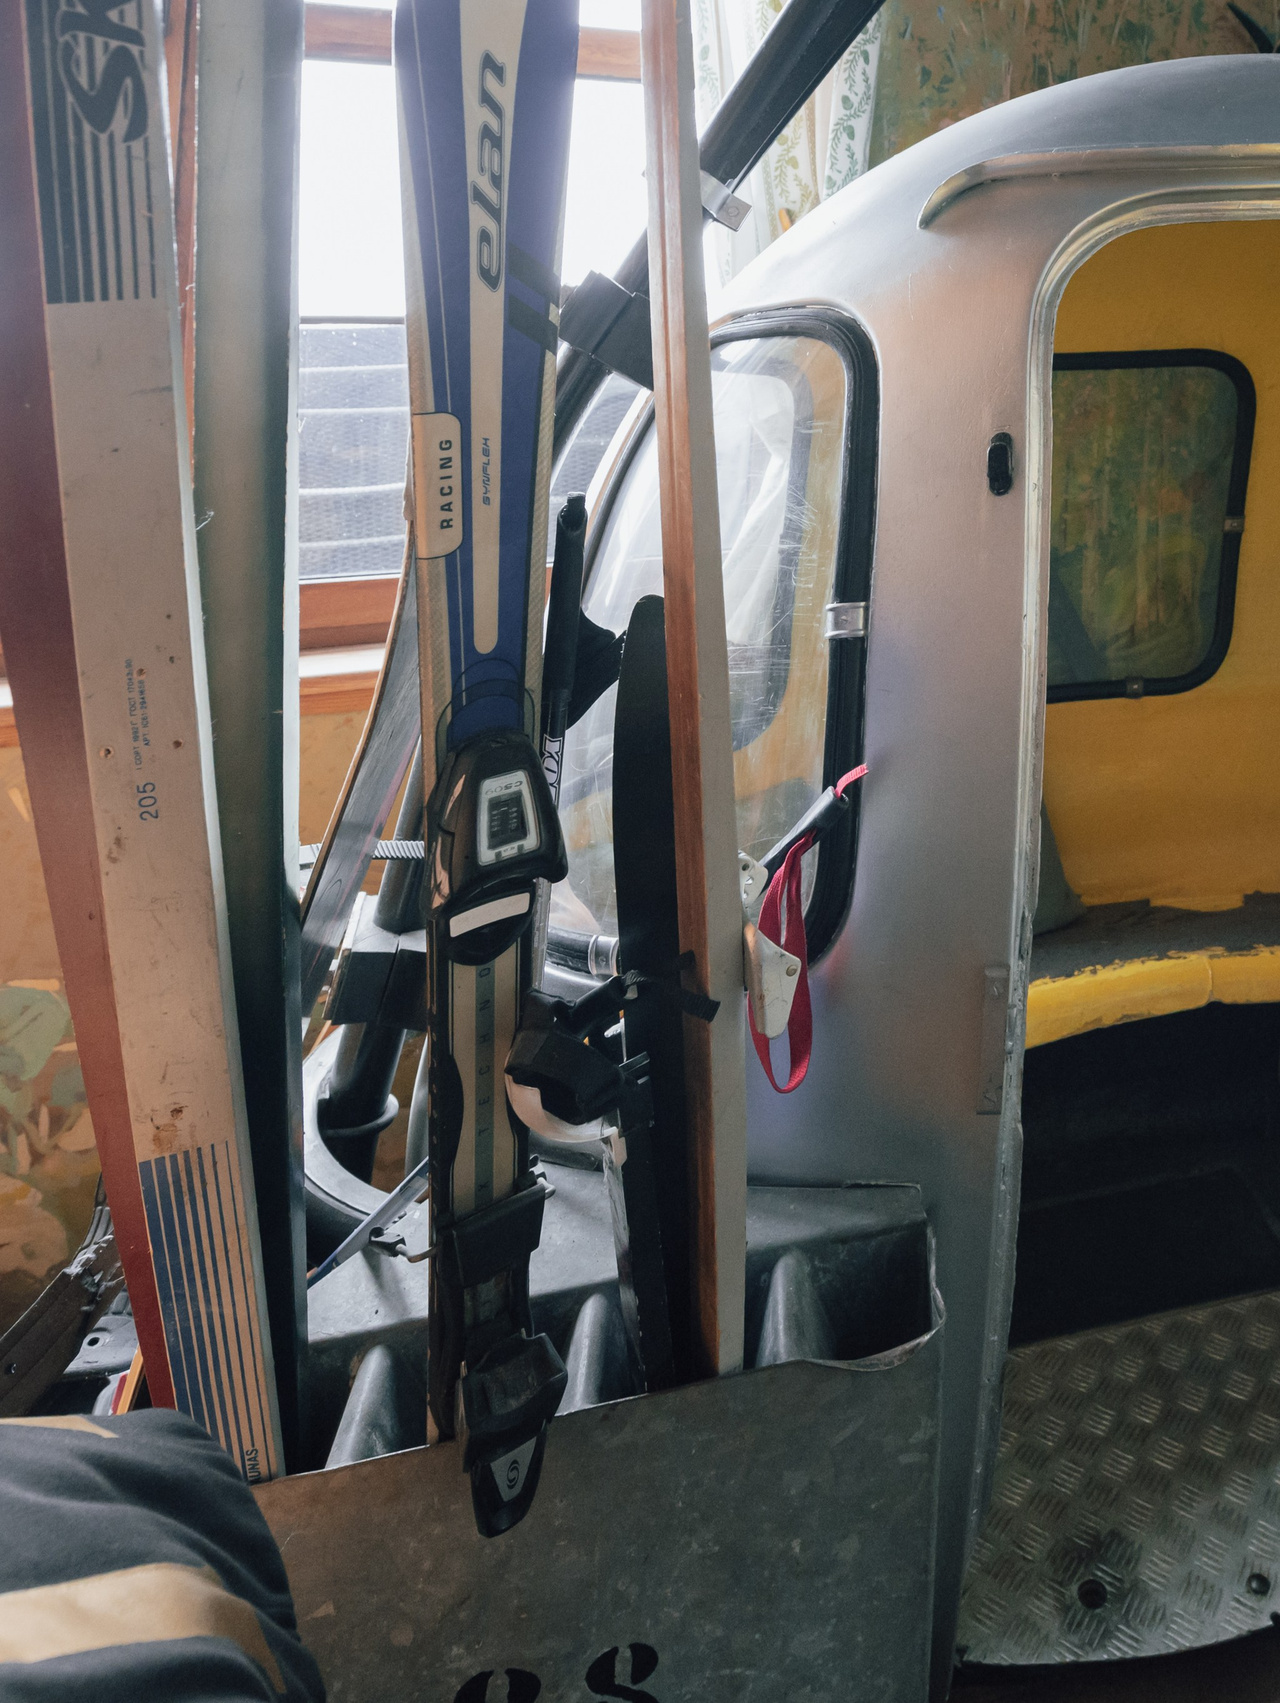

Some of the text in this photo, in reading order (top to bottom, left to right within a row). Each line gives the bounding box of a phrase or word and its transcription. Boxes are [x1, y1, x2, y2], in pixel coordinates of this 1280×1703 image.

[470, 50, 506, 292] elan
[439, 439, 453, 530] RACING
[136, 781, 159, 821] 205
[542, 734, 563, 808] YO
